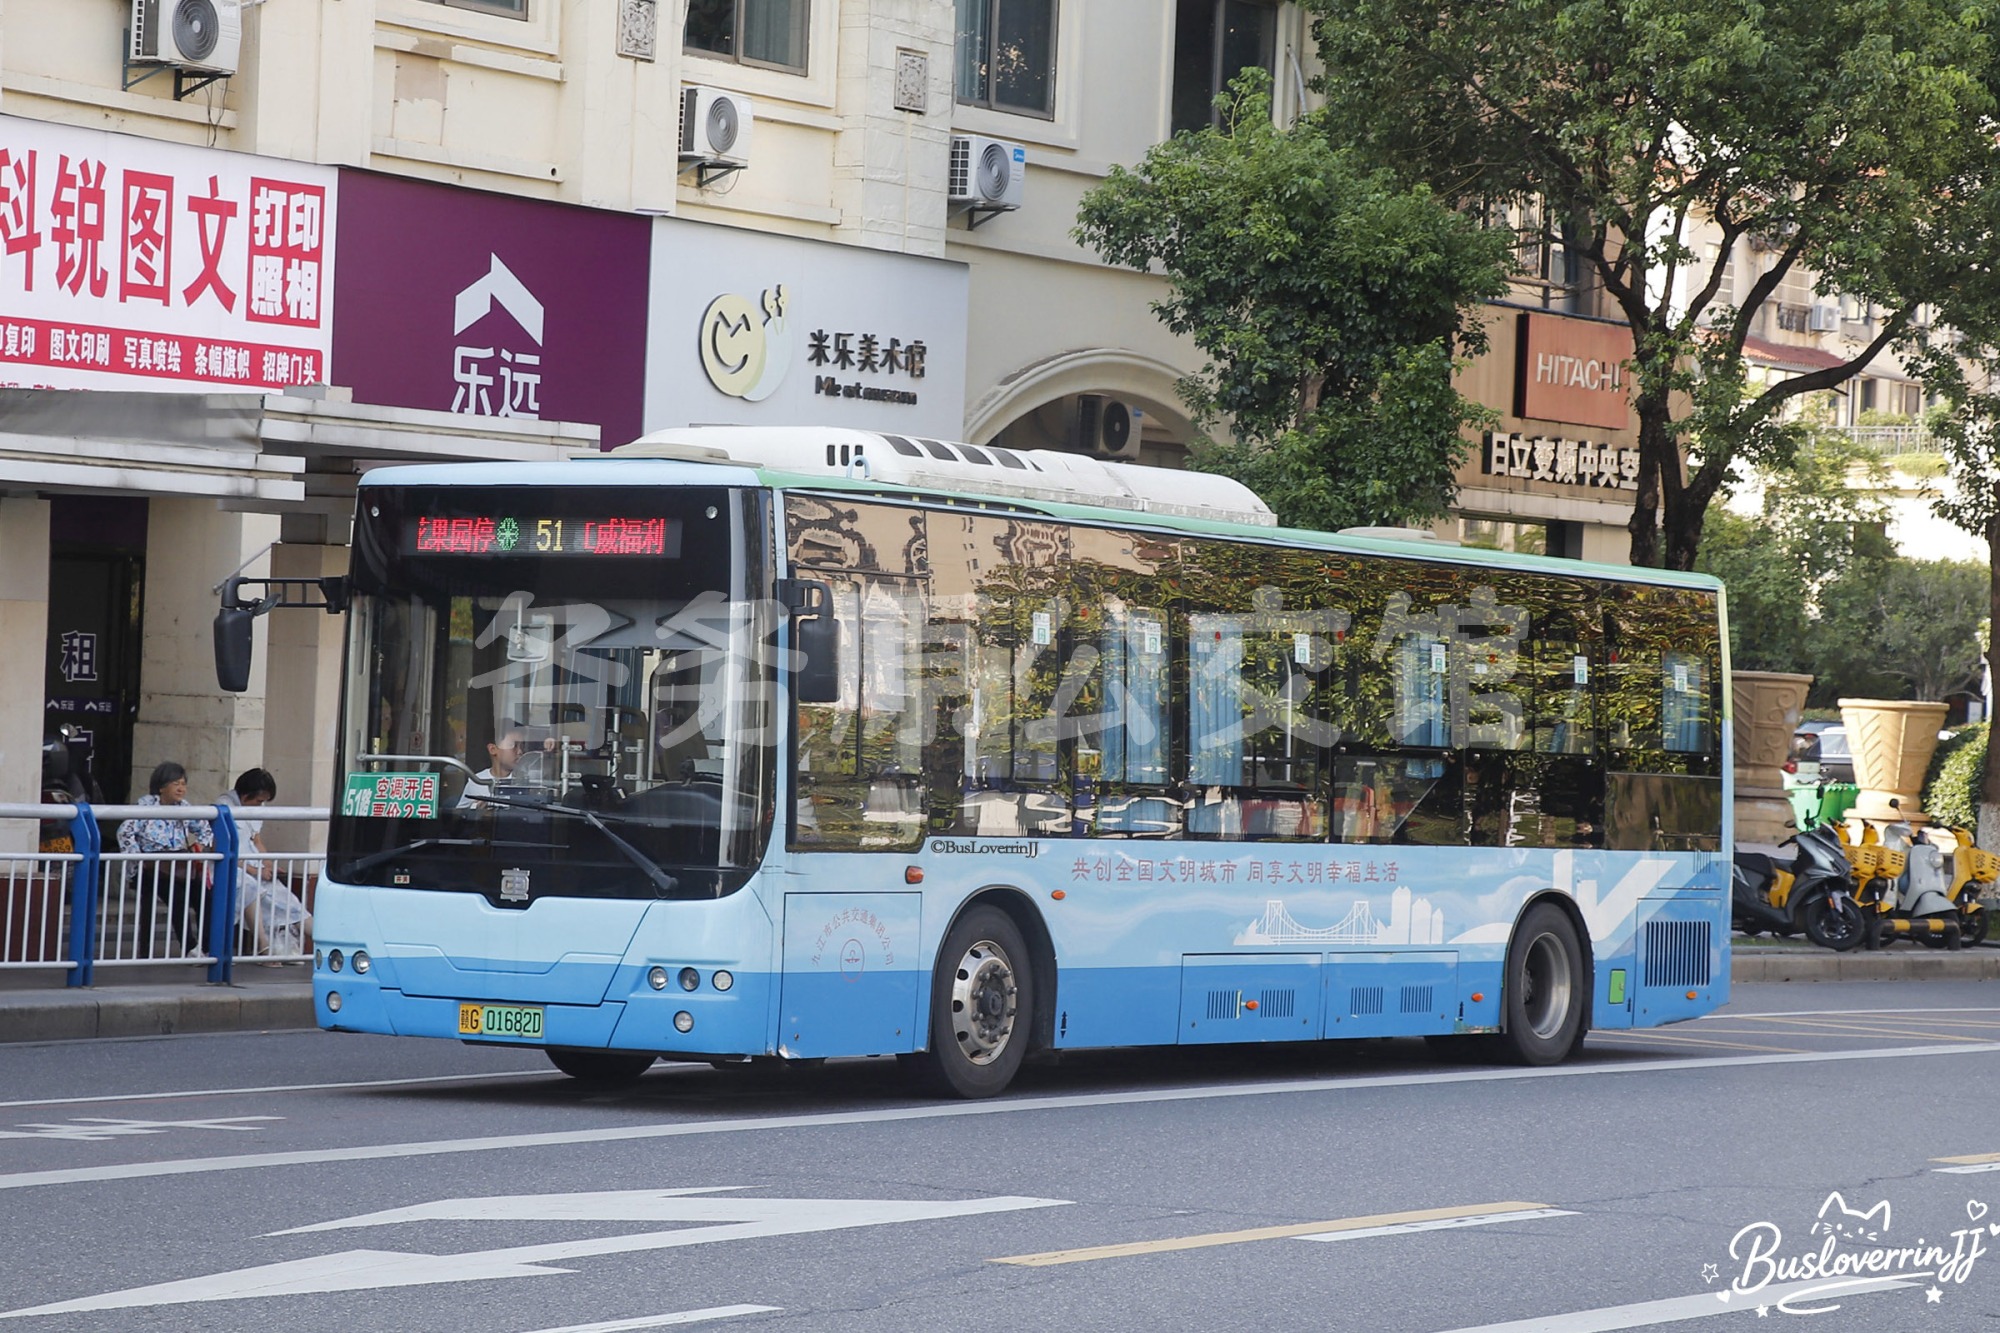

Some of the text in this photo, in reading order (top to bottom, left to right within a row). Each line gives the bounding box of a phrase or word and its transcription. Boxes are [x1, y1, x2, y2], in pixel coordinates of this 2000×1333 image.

[253, 186, 321, 252] 打印
[250, 254, 319, 320] 照相
[0, 322, 316, 386] 复印 图文印刷 写真喷绘 条幅旗帜 招牌门头
[807, 329, 927, 378] 米乐美术馆
[1536, 352, 1620, 393] HITACHI
[450, 346, 541, 420] 乐远
[536, 519, 564, 551] 51
[60, 631, 97, 682] 租
[375, 777, 434, 801] 空调开启
[1071, 857, 1399, 885] 共创全国文明城市 同享文明幸福生活
